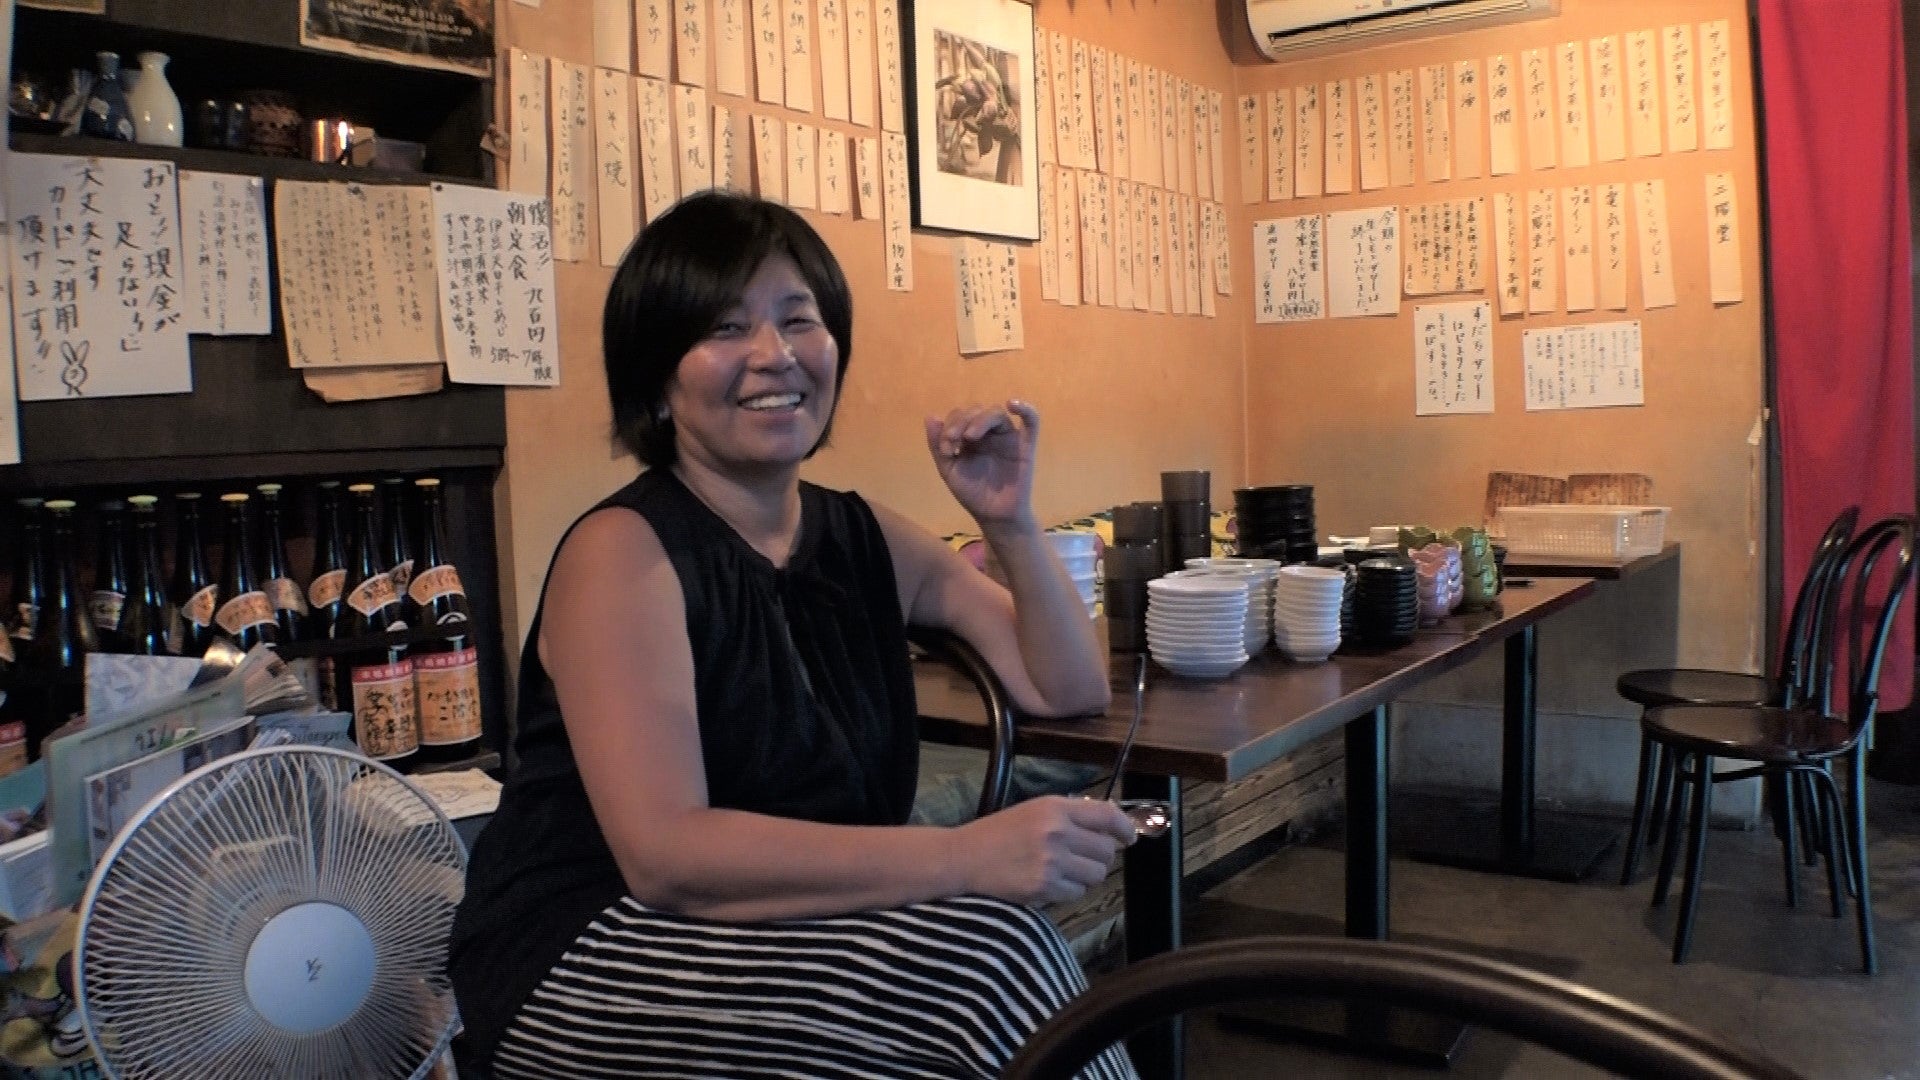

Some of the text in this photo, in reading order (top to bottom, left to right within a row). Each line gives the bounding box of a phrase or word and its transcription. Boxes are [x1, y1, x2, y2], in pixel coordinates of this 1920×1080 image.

[787, 0, 808, 55] 納豆
[72, 167, 104, 291] 大丈夫です
[506, 202, 528, 281] 朝定食
[523, 286, 546, 343] 九百円
